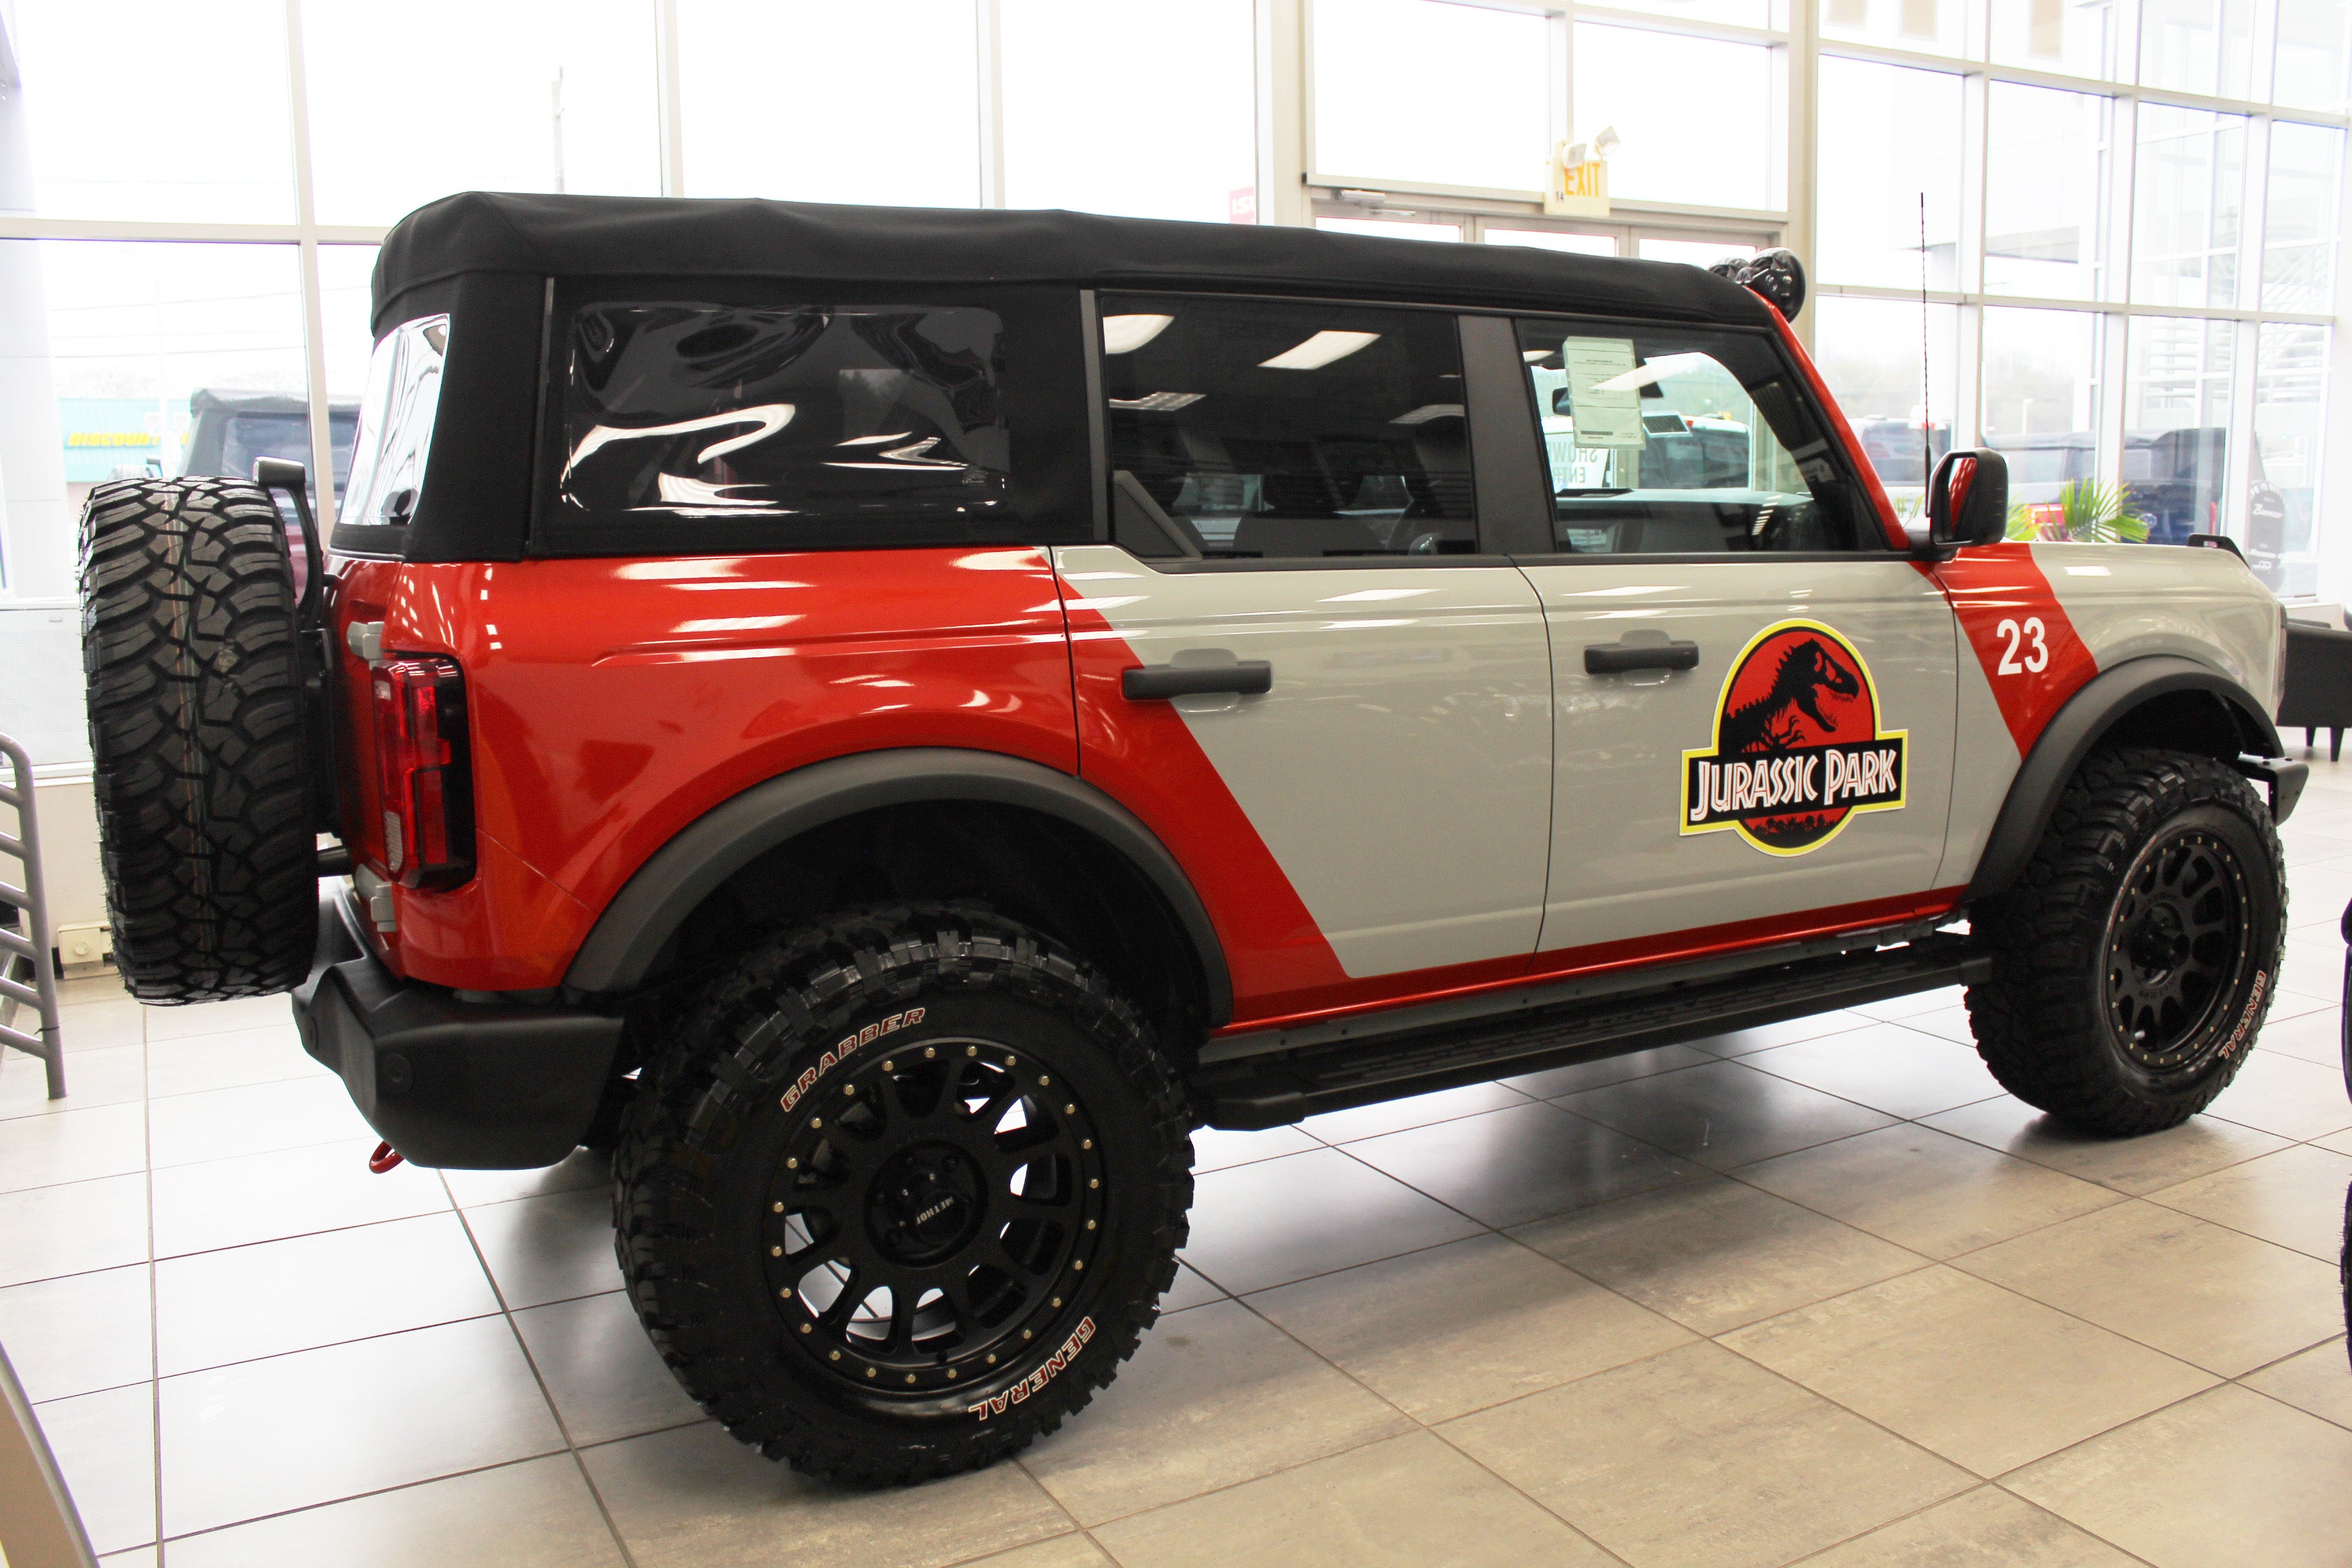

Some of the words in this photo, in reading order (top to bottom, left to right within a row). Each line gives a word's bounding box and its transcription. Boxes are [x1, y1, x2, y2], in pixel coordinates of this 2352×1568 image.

[1565, 162, 1601, 197] EXIT
[1997, 617, 2048, 676] 23
[1690, 755, 1818, 821] JURASSIC
[1824, 749, 1897, 806] PARK
[2218, 970, 2266, 1059] GENERAL
[781, 1008, 926, 1112] GRABBER
[968, 1316, 1096, 1421] GENERAL
